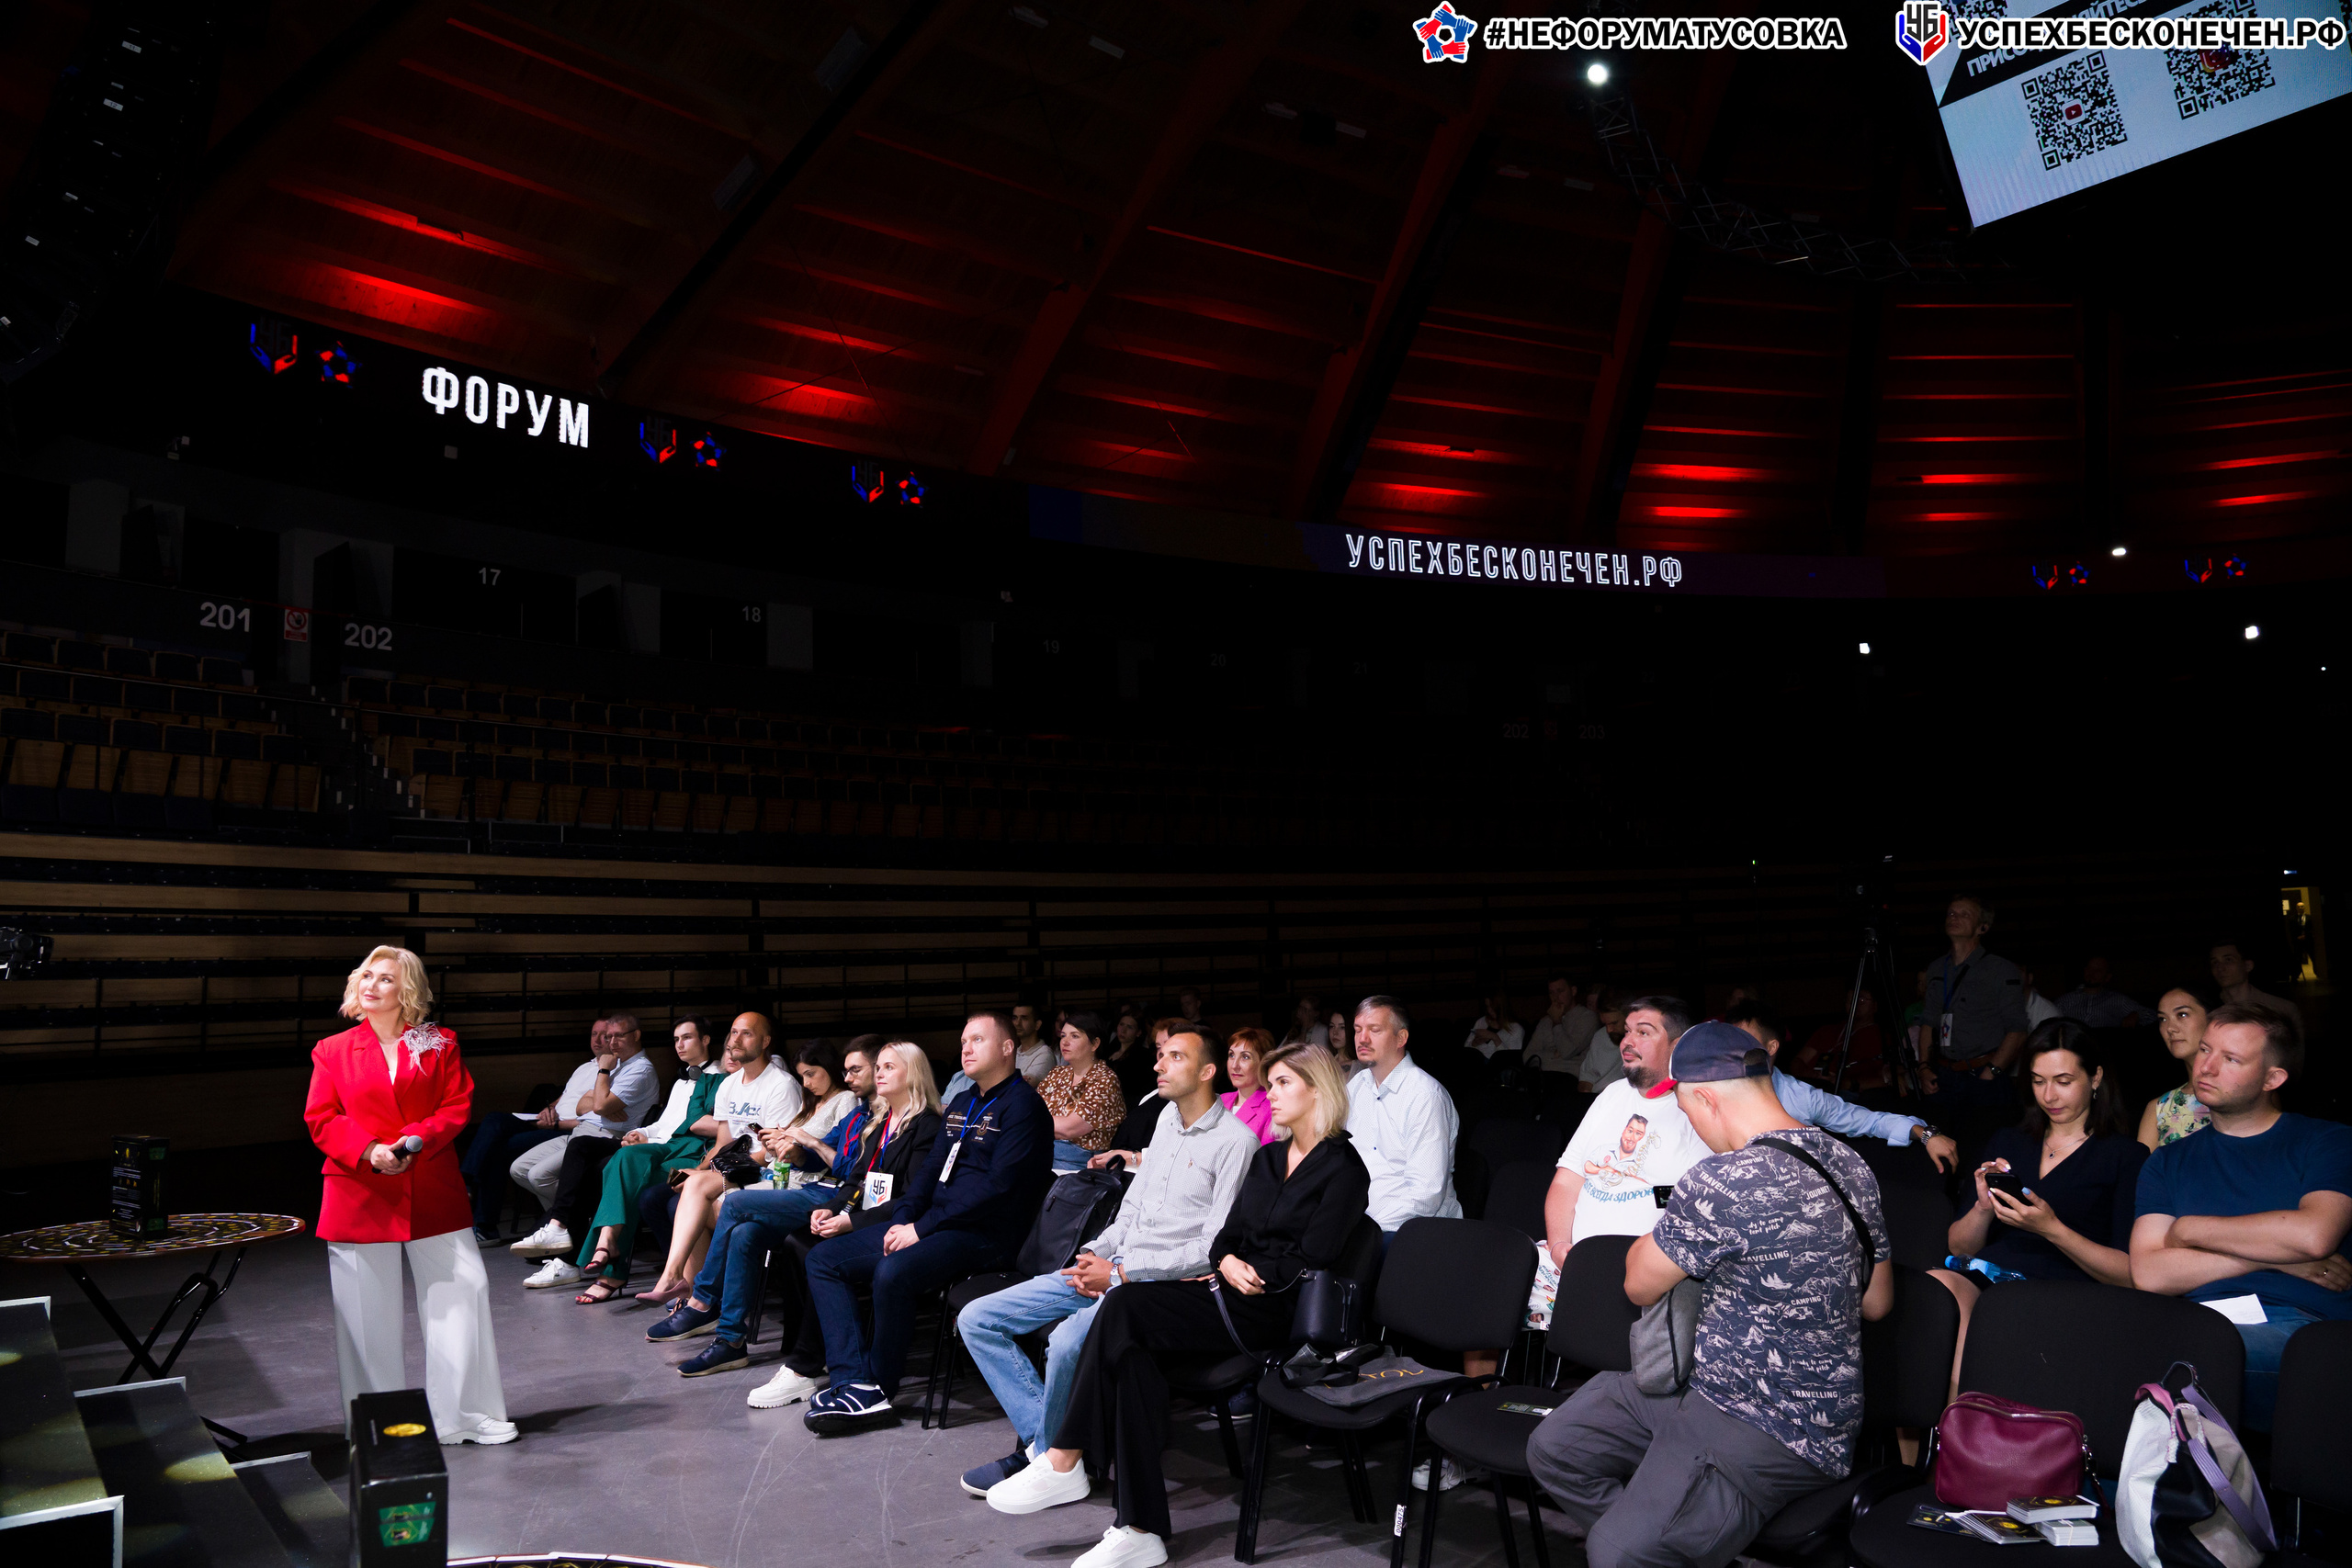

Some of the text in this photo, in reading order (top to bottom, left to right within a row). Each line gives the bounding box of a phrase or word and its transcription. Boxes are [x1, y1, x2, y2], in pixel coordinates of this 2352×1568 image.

[422, 367, 590, 448] ФОРУМ
[1345, 534, 1683, 588] УСПЕХБЕСКОНЕЧЕН.РФ
[479, 567, 502, 586] 17
[199, 602, 251, 633] 201
[741, 605, 762, 623] 18
[345, 623, 393, 651] 202
[1043, 639, 1060, 655] 19
[1502, 723, 1530, 739] 202
[1578, 724, 1606, 739] 203
[1736, 1156, 1764, 1167] CAMPING
[1699, 1170, 1740, 1202] TRAVELLING
[1613, 1188, 1654, 1203] ЗДОРОВ
[1791, 1295, 1822, 1306] CAMPING
[1791, 1390, 1838, 1399] TRAVELLING
